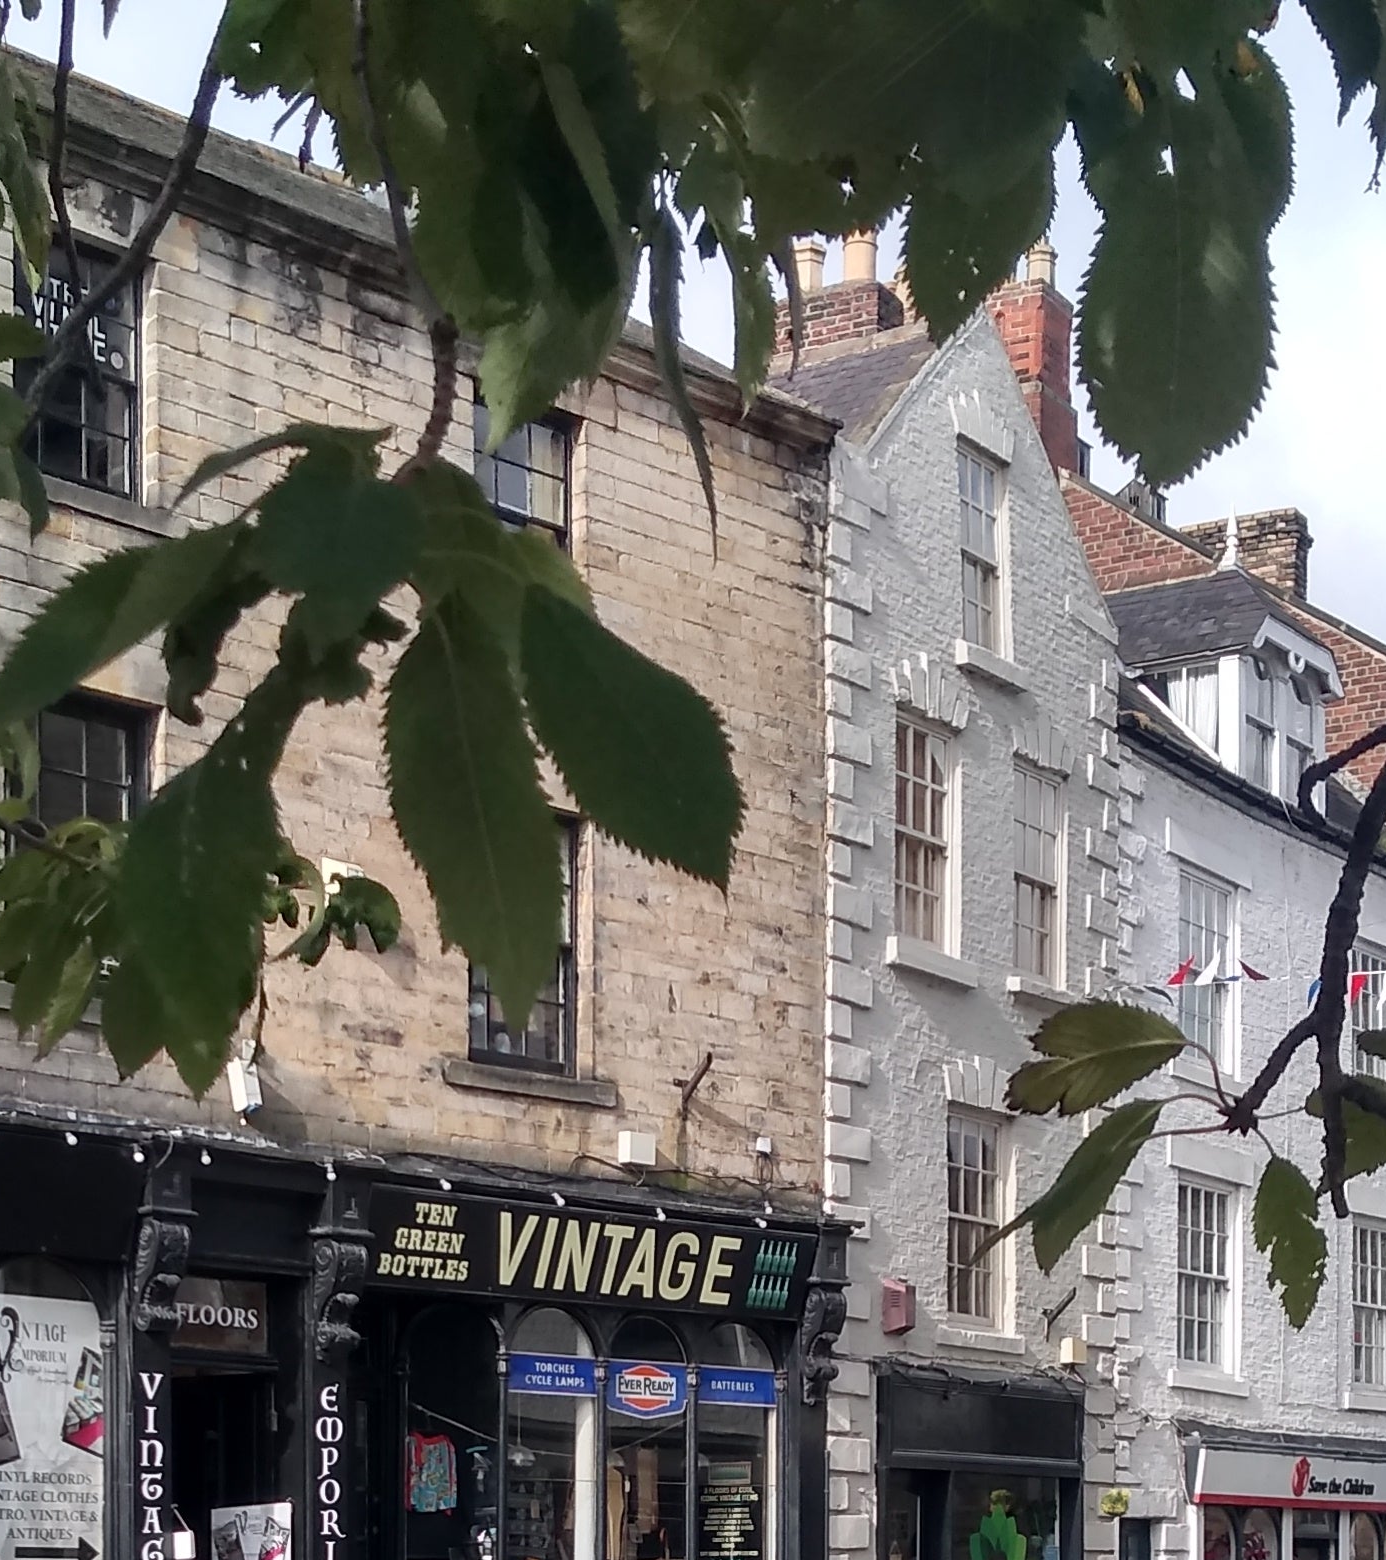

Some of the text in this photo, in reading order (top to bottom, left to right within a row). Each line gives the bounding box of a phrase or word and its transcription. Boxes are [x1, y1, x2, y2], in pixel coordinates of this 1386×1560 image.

[415, 1201, 458, 1227] TEN
[394, 1227, 466, 1255] GREEN
[376, 1252, 469, 1282] BOTTLES
[498, 1210, 743, 1306] VINTAGE
[174, 1302, 259, 1329] FLOORS
[534, 1362, 576, 1375] TORCHES
[524, 1374, 585, 1389] CYCLE LAMPS
[618, 1374, 675, 1396] EVER READY
[710, 1380, 755, 1393] BATTERIES
[32, 1471, 93, 1486] RECORDS
[1308, 1475, 1375, 1496] Save the Children
[40, 1490, 99, 1504] CLOTHES
[29, 1509, 88, 1522] VINTAGE
[89, 1510, 99, 1522] &
[6, 1527, 74, 1543] ANTIQUES
